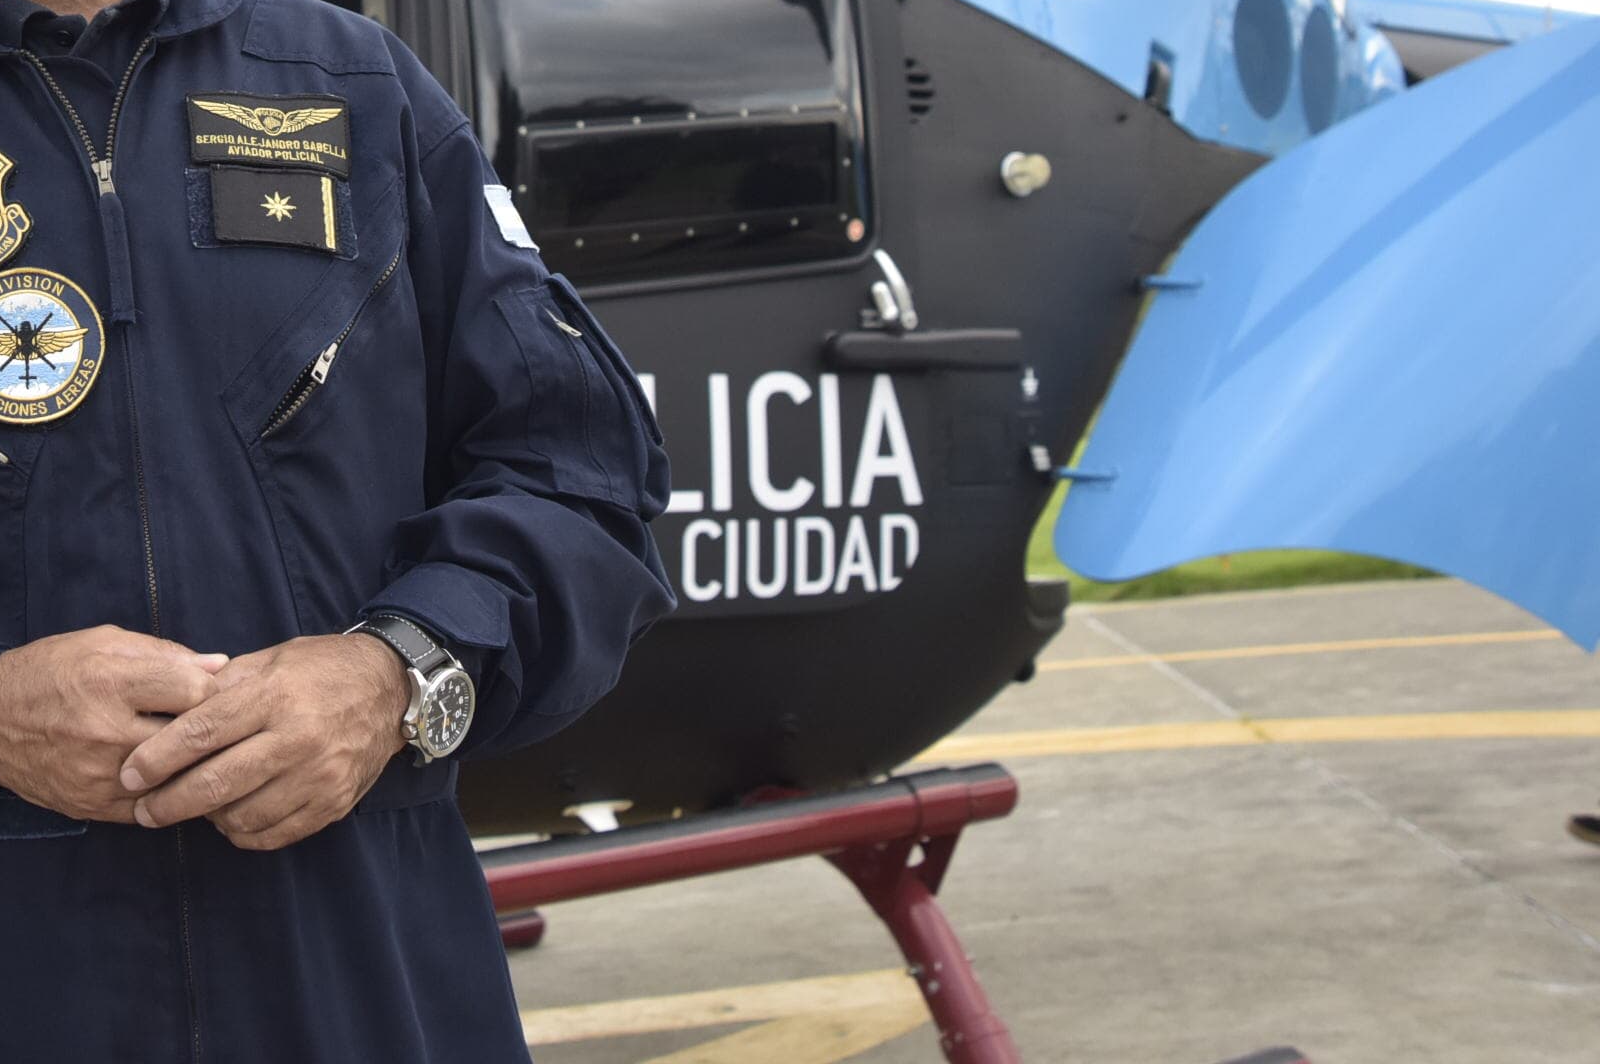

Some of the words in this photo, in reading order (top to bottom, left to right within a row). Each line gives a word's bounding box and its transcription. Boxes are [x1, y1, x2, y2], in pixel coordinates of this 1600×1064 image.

[195, 134, 235, 145] SERGIO
[237, 135, 300, 150] ALEJANDRO
[228, 145, 273, 159] AVIADOR
[275, 150, 324, 164] POLICIAL
[55, 357, 96, 409] AEREAS
[681, 513, 920, 602] CIUDAD
